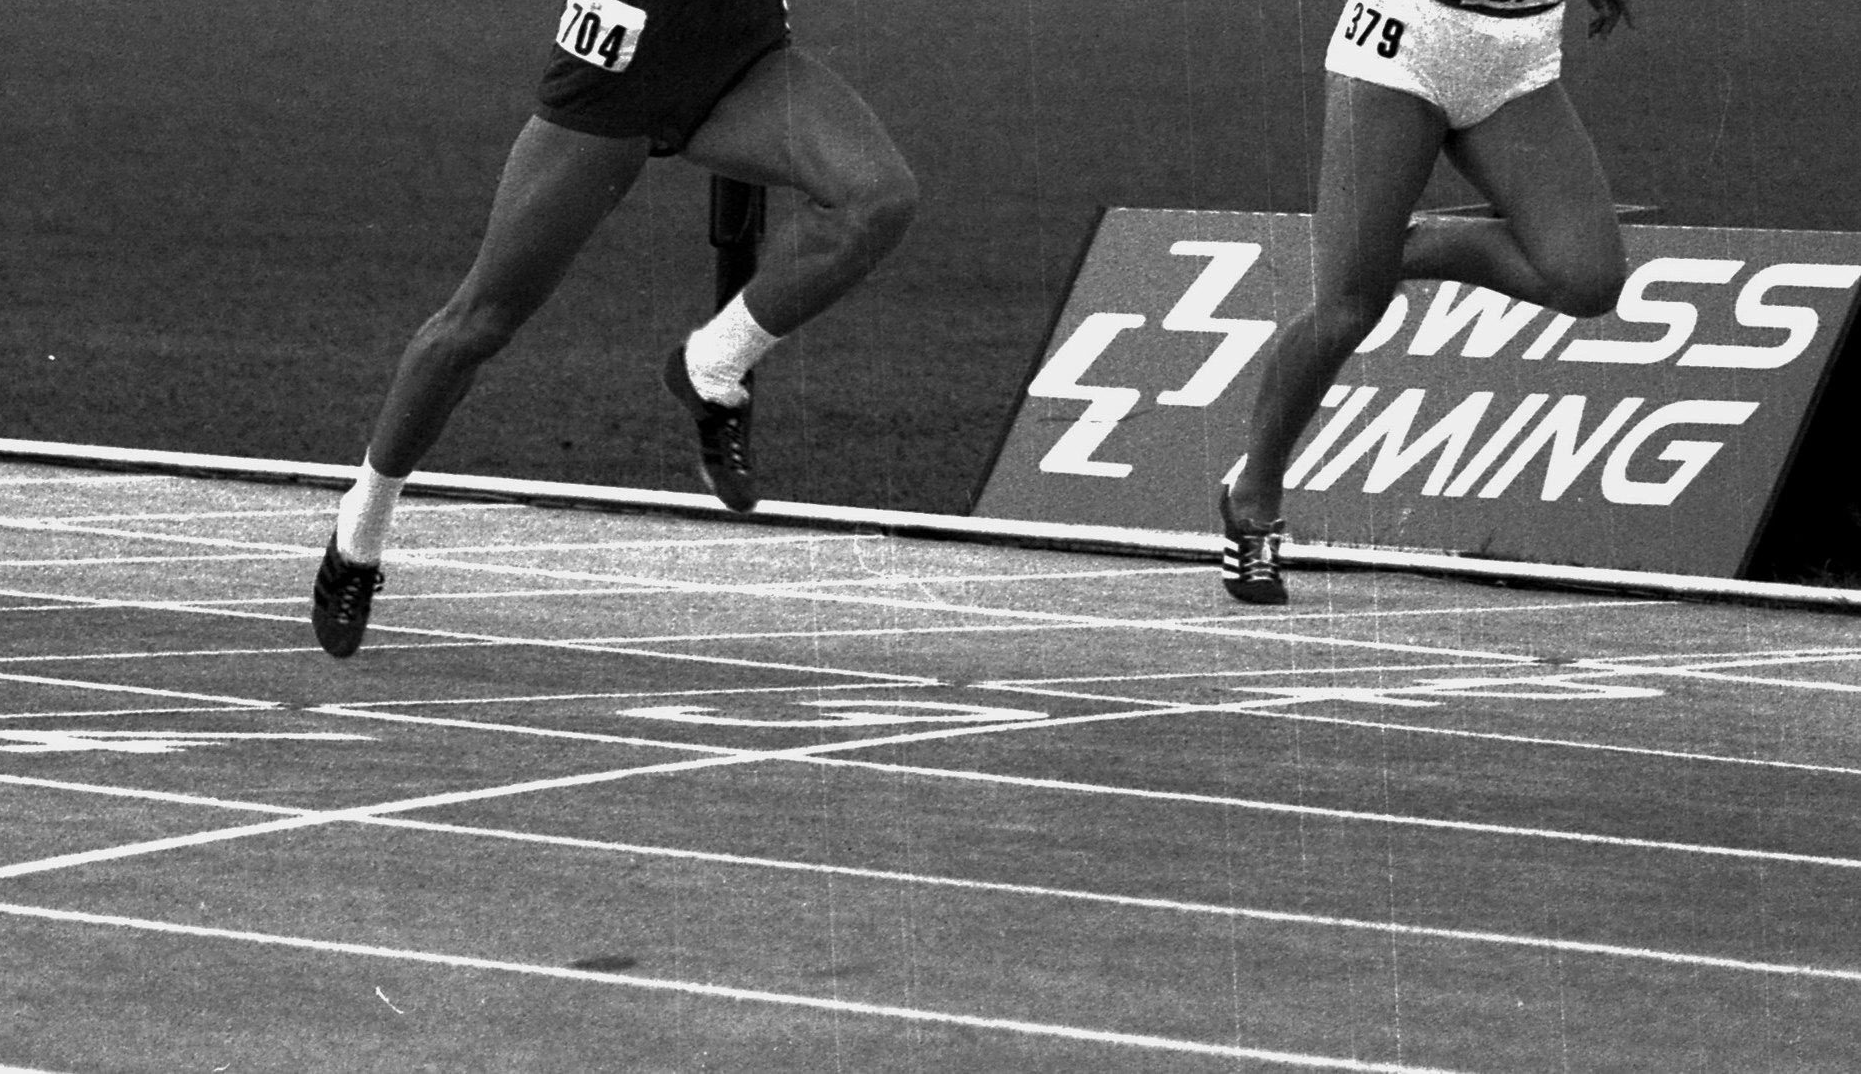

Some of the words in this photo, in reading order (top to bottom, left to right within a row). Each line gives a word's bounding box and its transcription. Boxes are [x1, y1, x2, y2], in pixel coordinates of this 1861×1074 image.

[561, 3, 627, 68] 704
[1345, 3, 1404, 59] 379
[1355, 258, 1861, 369] WSS
[1221, 385, 1760, 506] IMING
